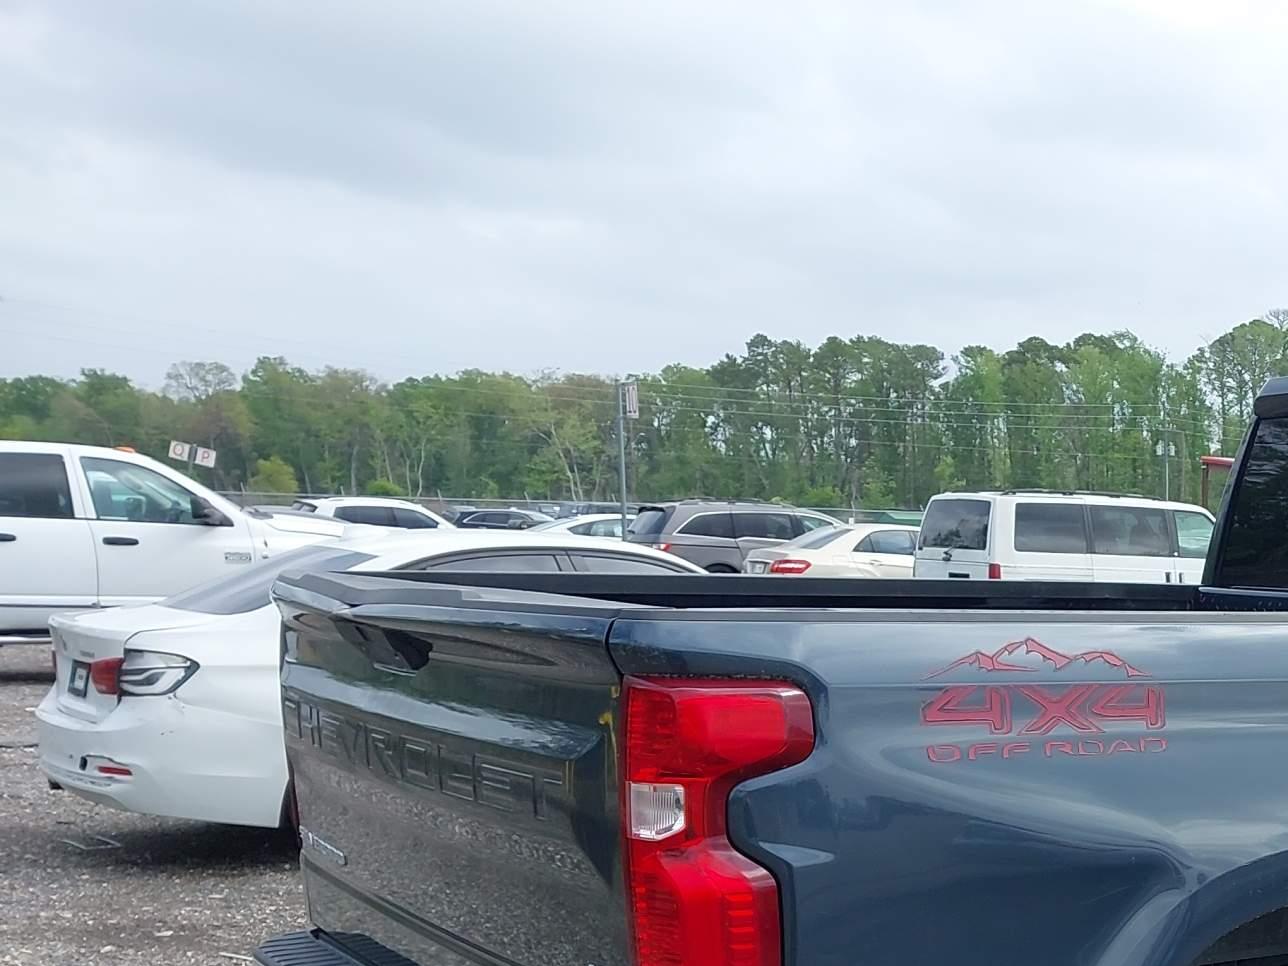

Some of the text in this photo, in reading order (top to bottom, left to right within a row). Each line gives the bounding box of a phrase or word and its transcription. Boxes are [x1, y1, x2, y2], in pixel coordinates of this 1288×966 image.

[201, 450, 210, 463] P
[926, 736, 1169, 763] OFF ROAD
